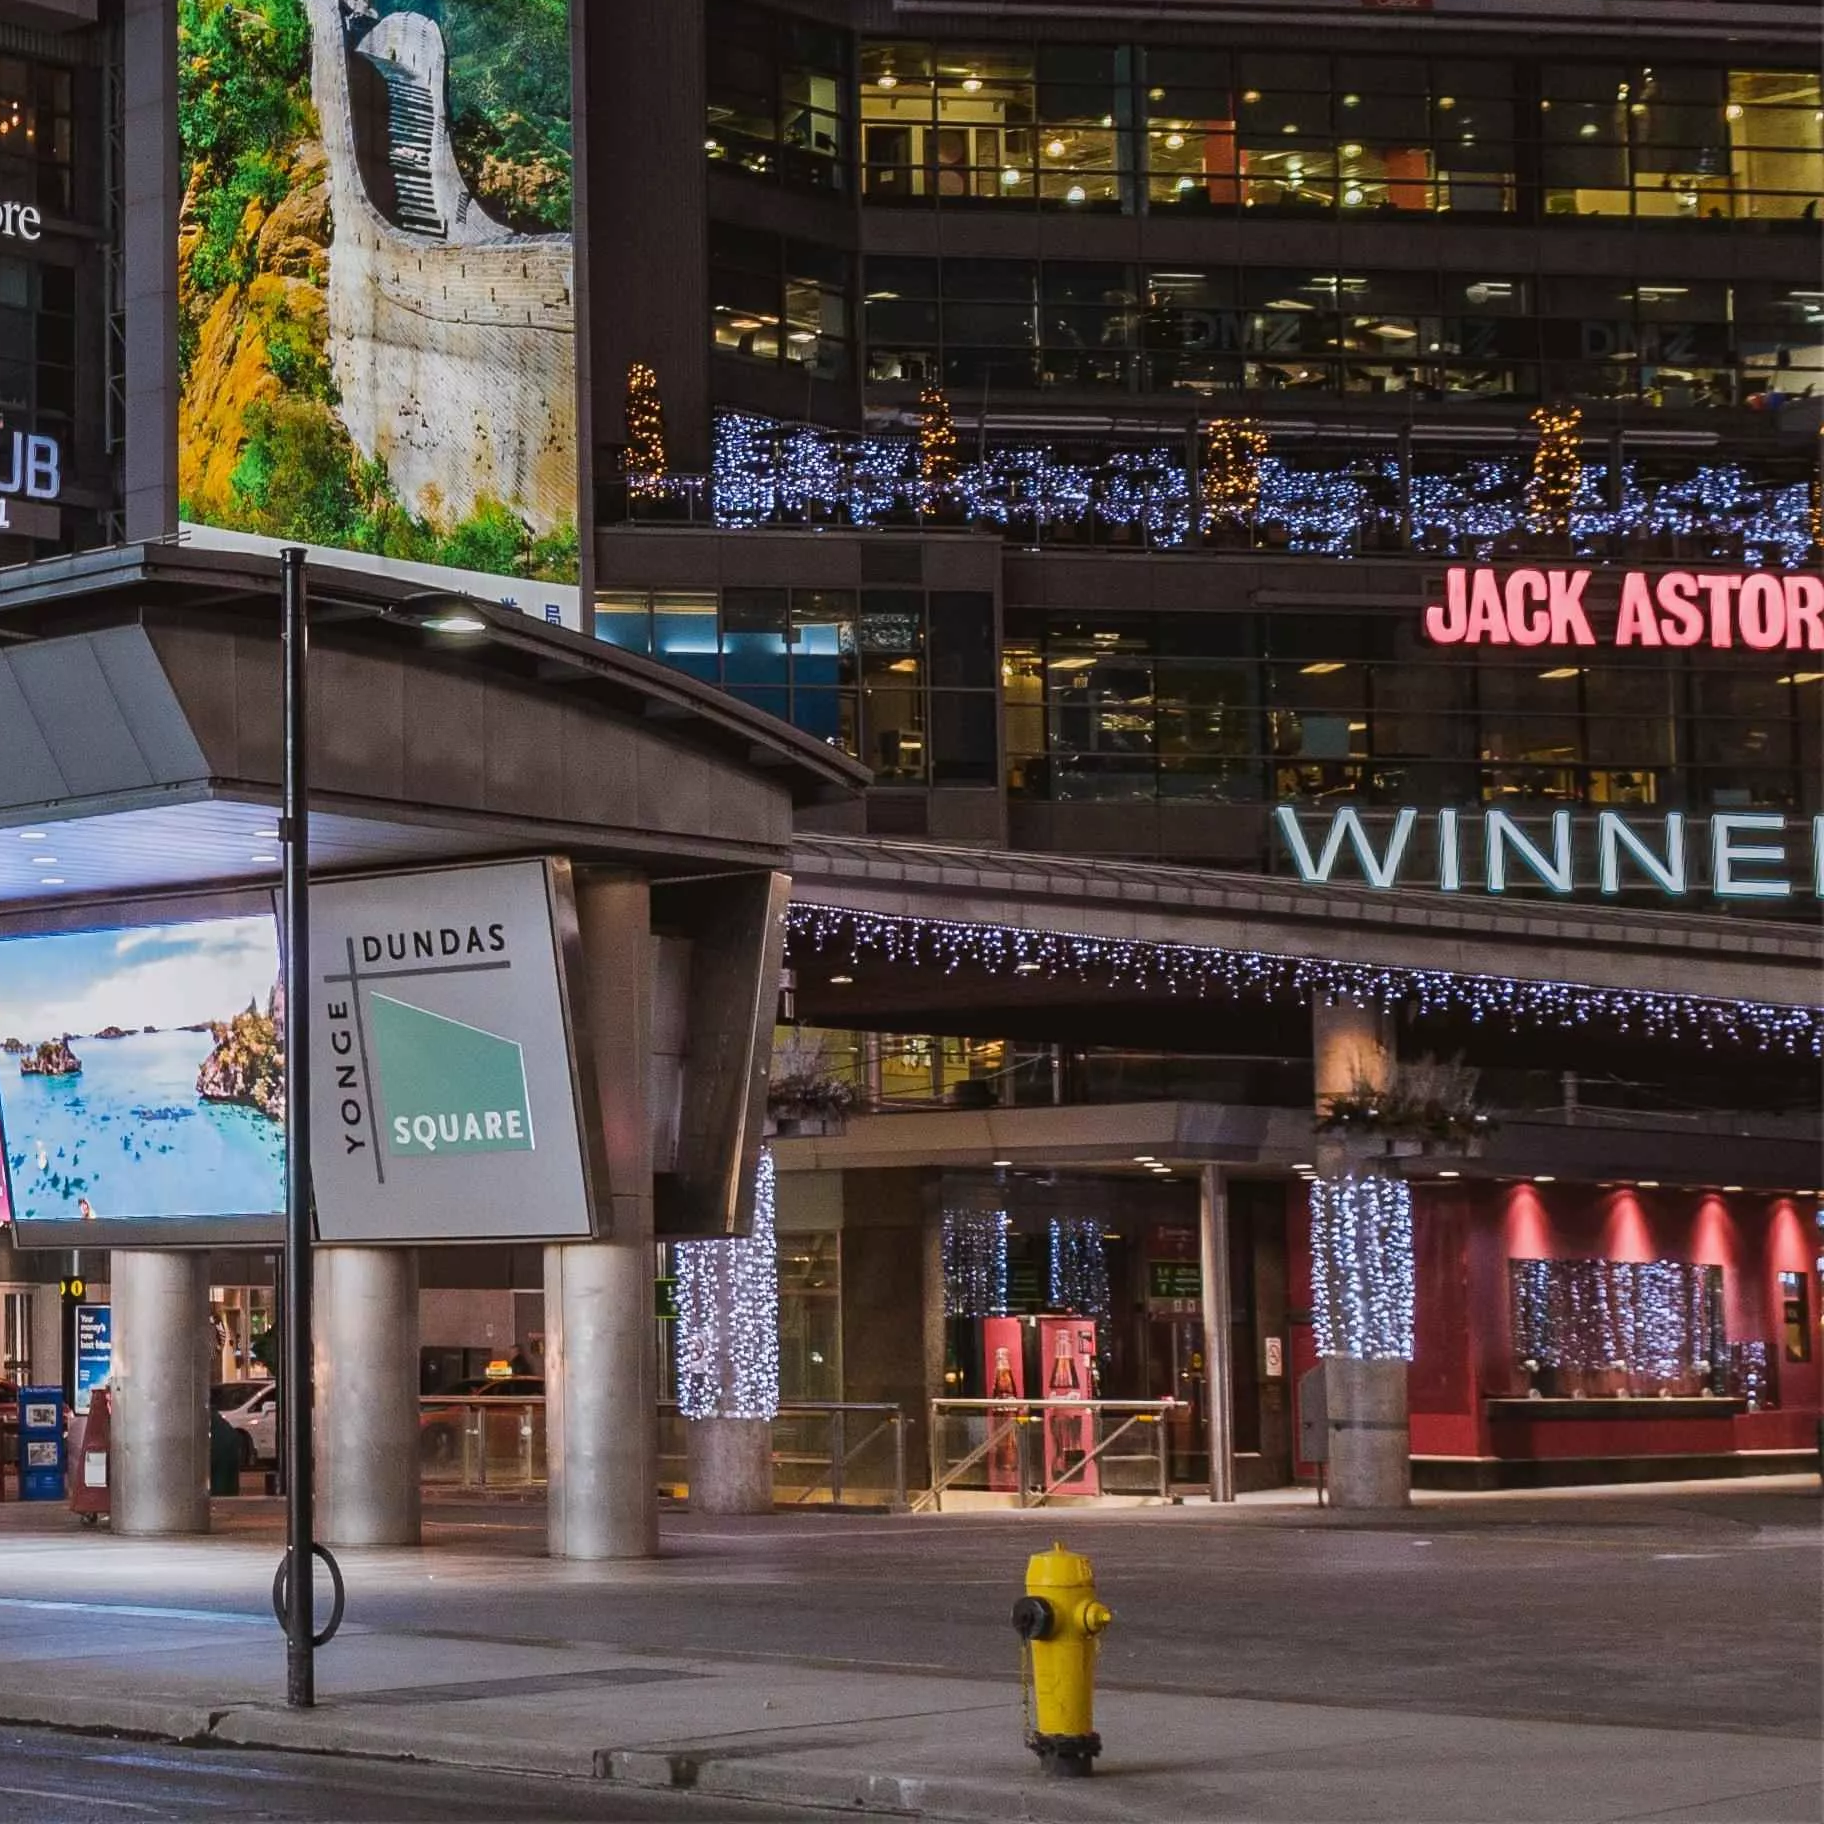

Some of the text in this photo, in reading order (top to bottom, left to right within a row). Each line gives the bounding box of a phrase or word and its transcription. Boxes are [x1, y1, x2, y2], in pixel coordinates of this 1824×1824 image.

[1426, 567, 1824, 651] JACK ASTOR
[362, 923, 506, 962] DUNDAS
[328, 1001, 366, 1156] YONGE
[393, 1109, 525, 1151] SQUARE
